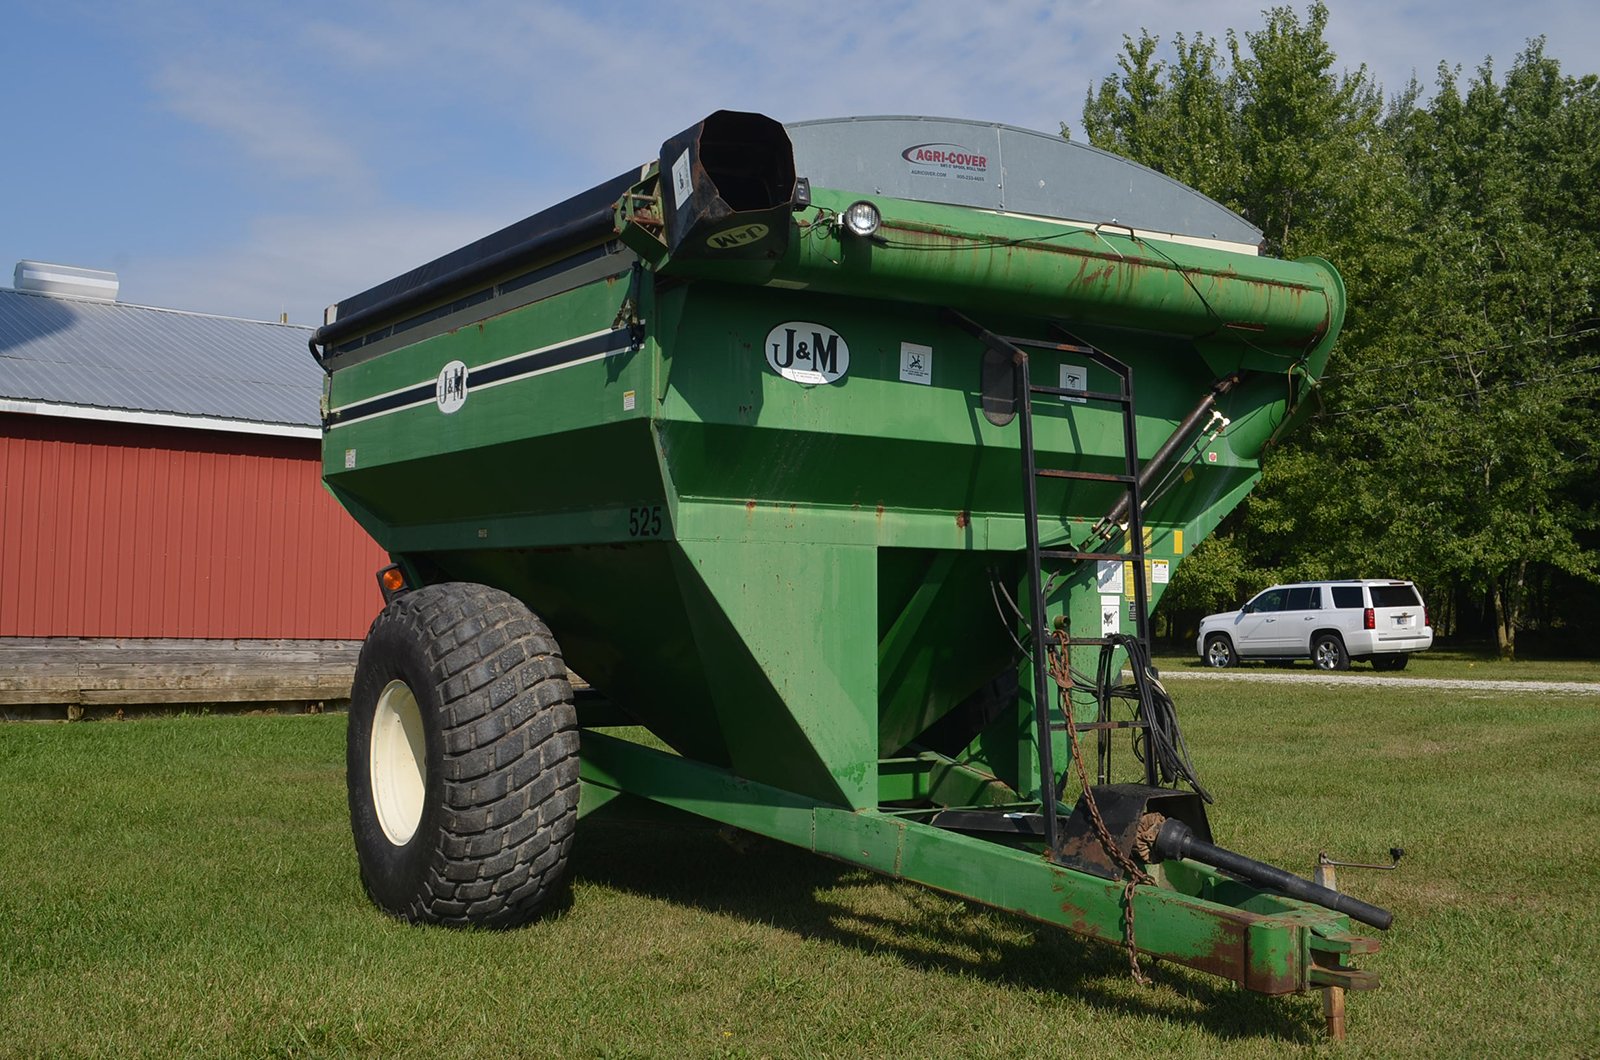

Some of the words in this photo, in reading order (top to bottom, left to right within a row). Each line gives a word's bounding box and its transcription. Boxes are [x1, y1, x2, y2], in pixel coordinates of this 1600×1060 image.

[916, 149, 987, 168] AGRI-COVER
[772, 328, 839, 374] J&M
[439, 365, 465, 404] J&M
[629, 506, 662, 537] 525
